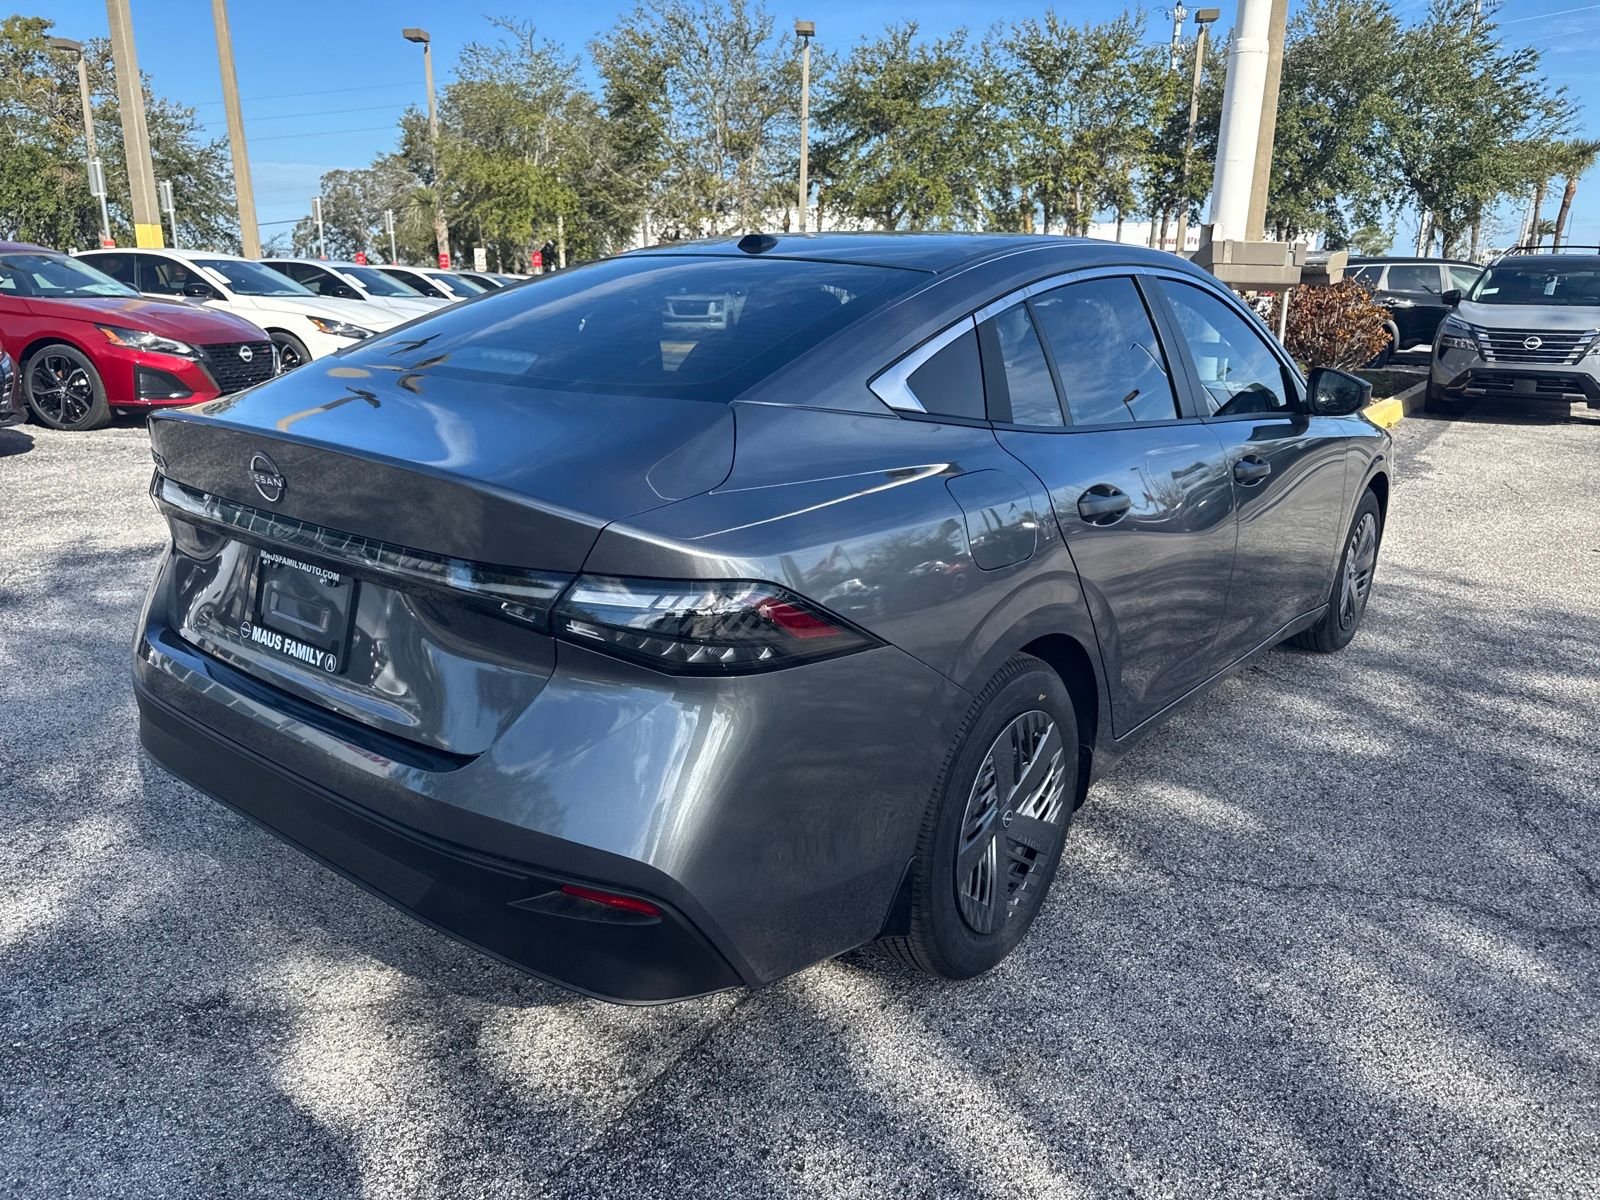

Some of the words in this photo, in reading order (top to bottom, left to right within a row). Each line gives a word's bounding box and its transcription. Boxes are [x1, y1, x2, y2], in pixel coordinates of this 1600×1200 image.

[249, 471, 282, 488] SSAN
[260, 549, 340, 581] MAUSFAMILYAUTO.COM
[252, 625, 282, 650] MAUS
[283, 638, 324, 666] FAMILY
